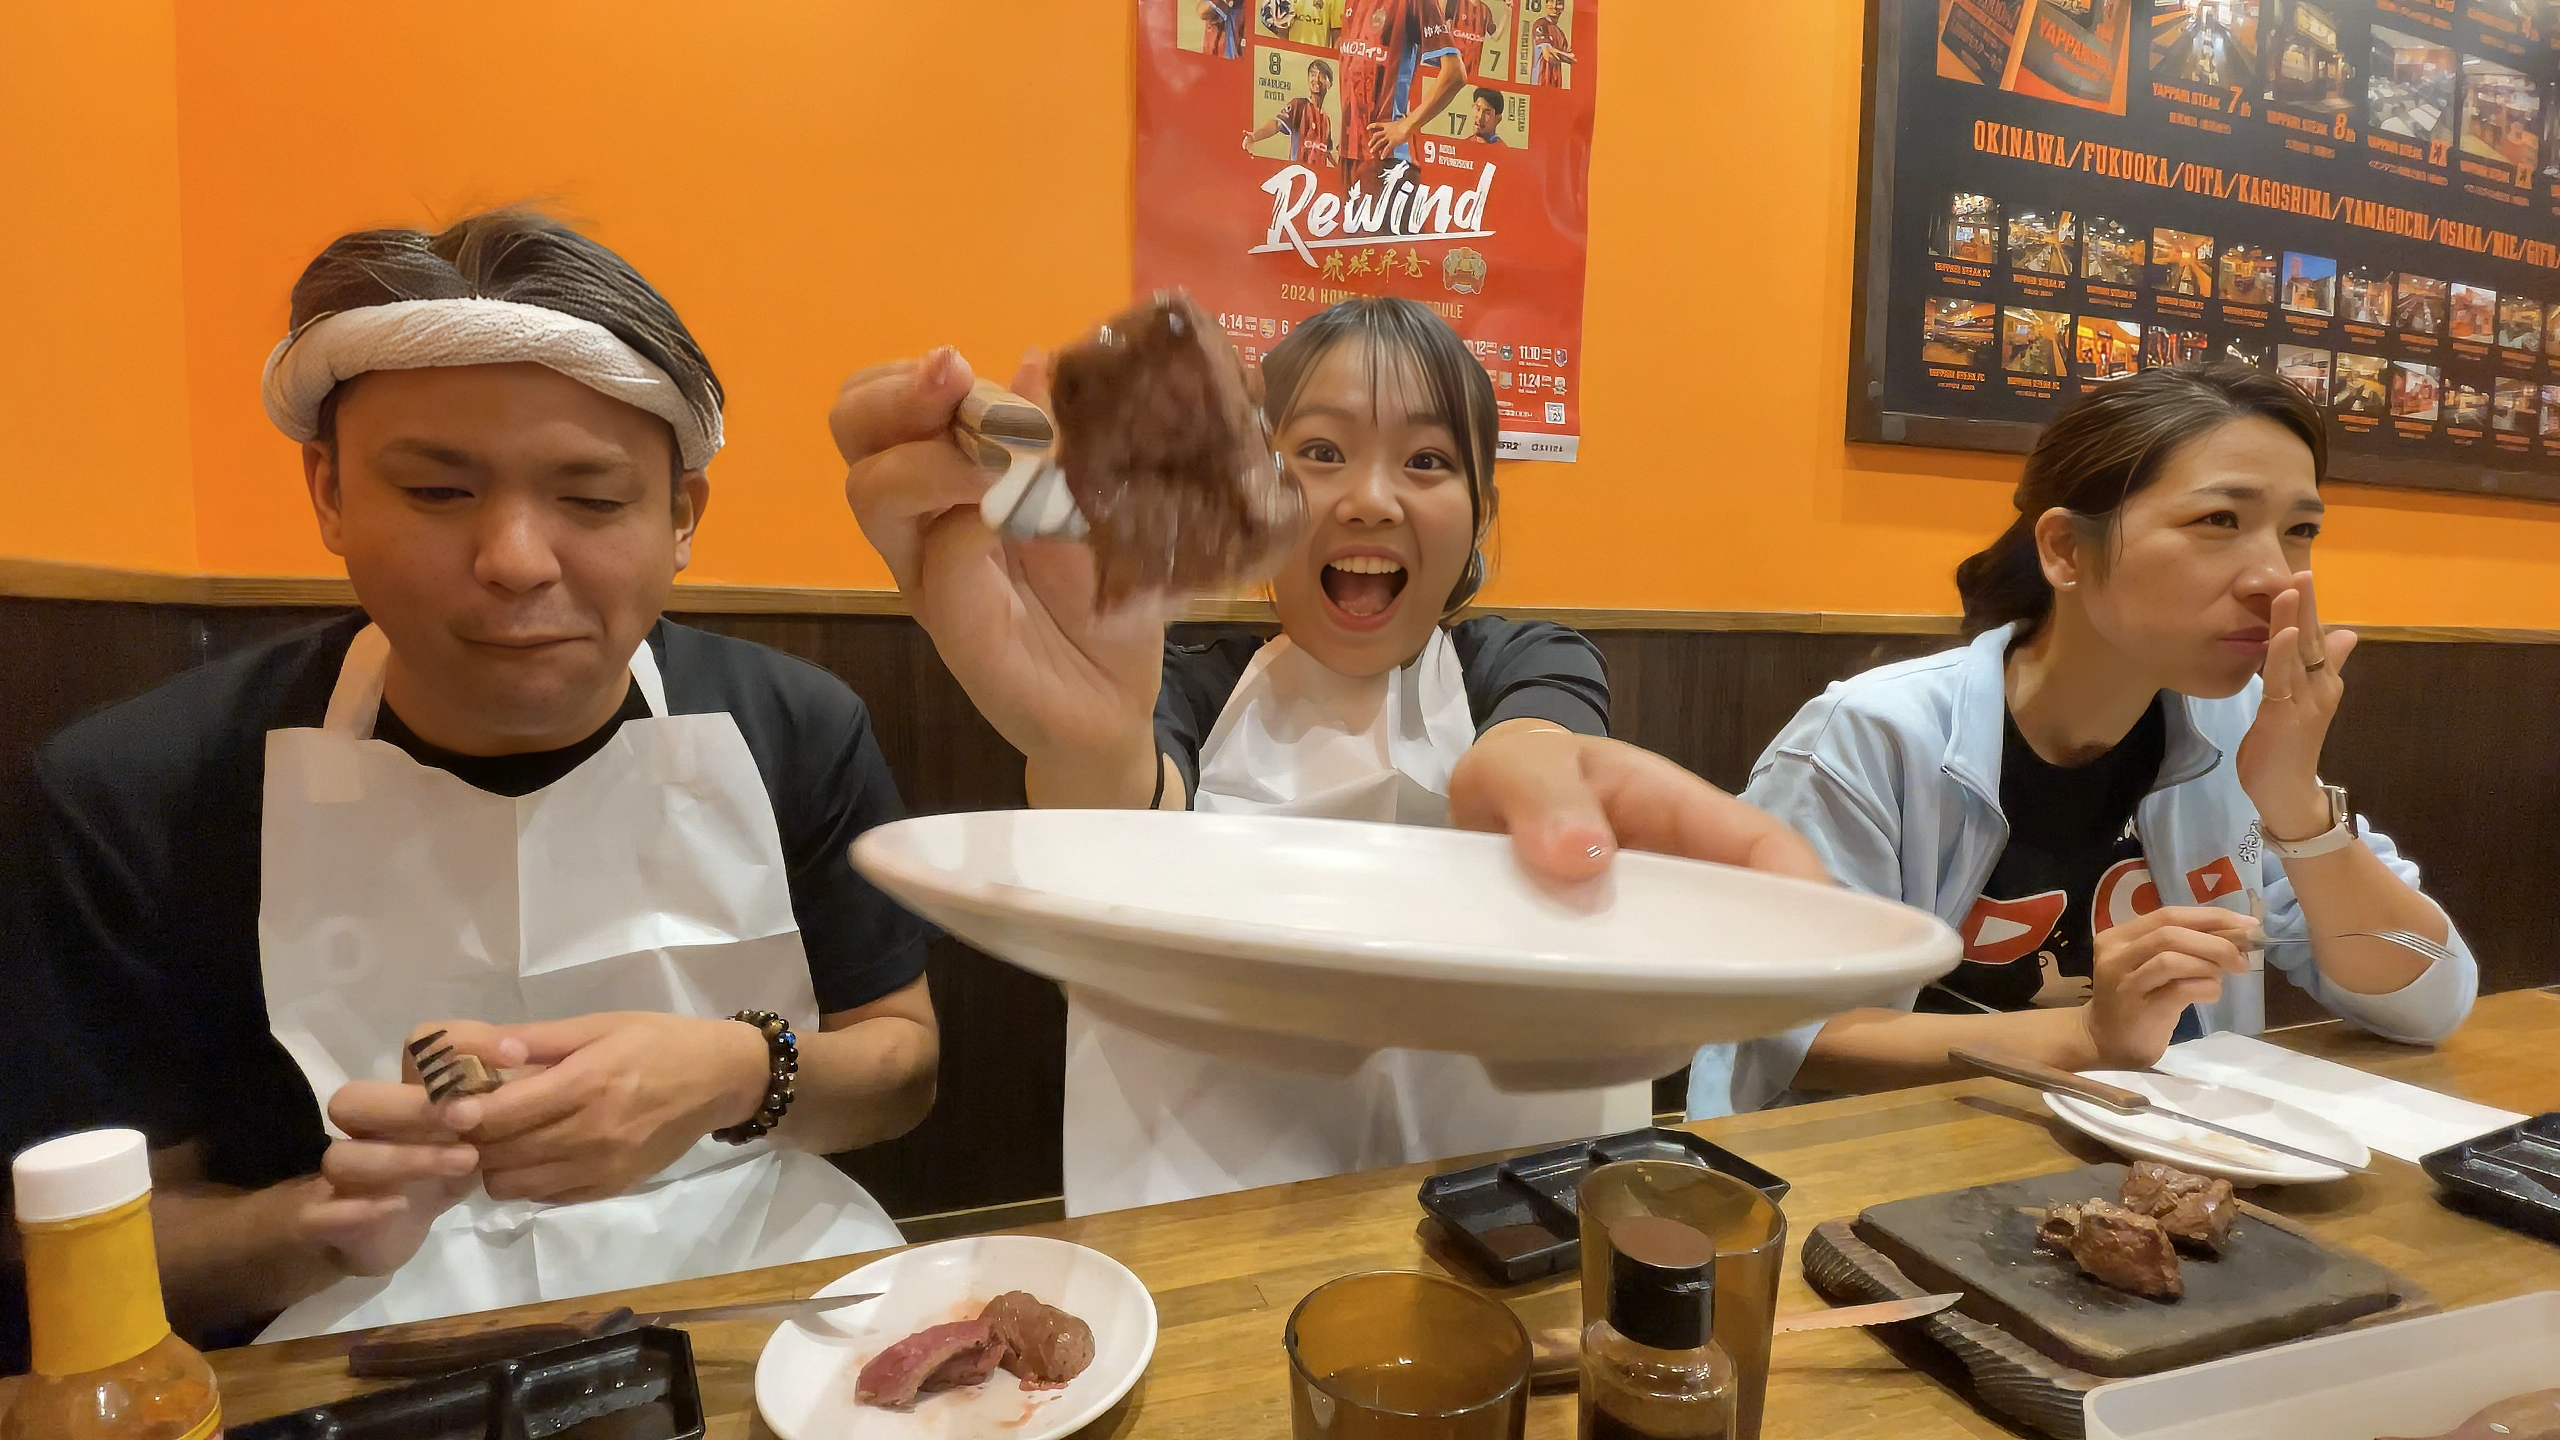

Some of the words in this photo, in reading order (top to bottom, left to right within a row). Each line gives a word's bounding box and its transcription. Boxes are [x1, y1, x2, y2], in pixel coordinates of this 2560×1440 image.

[1269, 52, 1281, 75] 8
[1489, 50, 1500, 72] 7
[1448, 112, 1467, 136] 17
[1424, 140, 1436, 164] 9
[1281, 283, 1315, 303] 2024
[1219, 312, 1242, 330] 4.14
